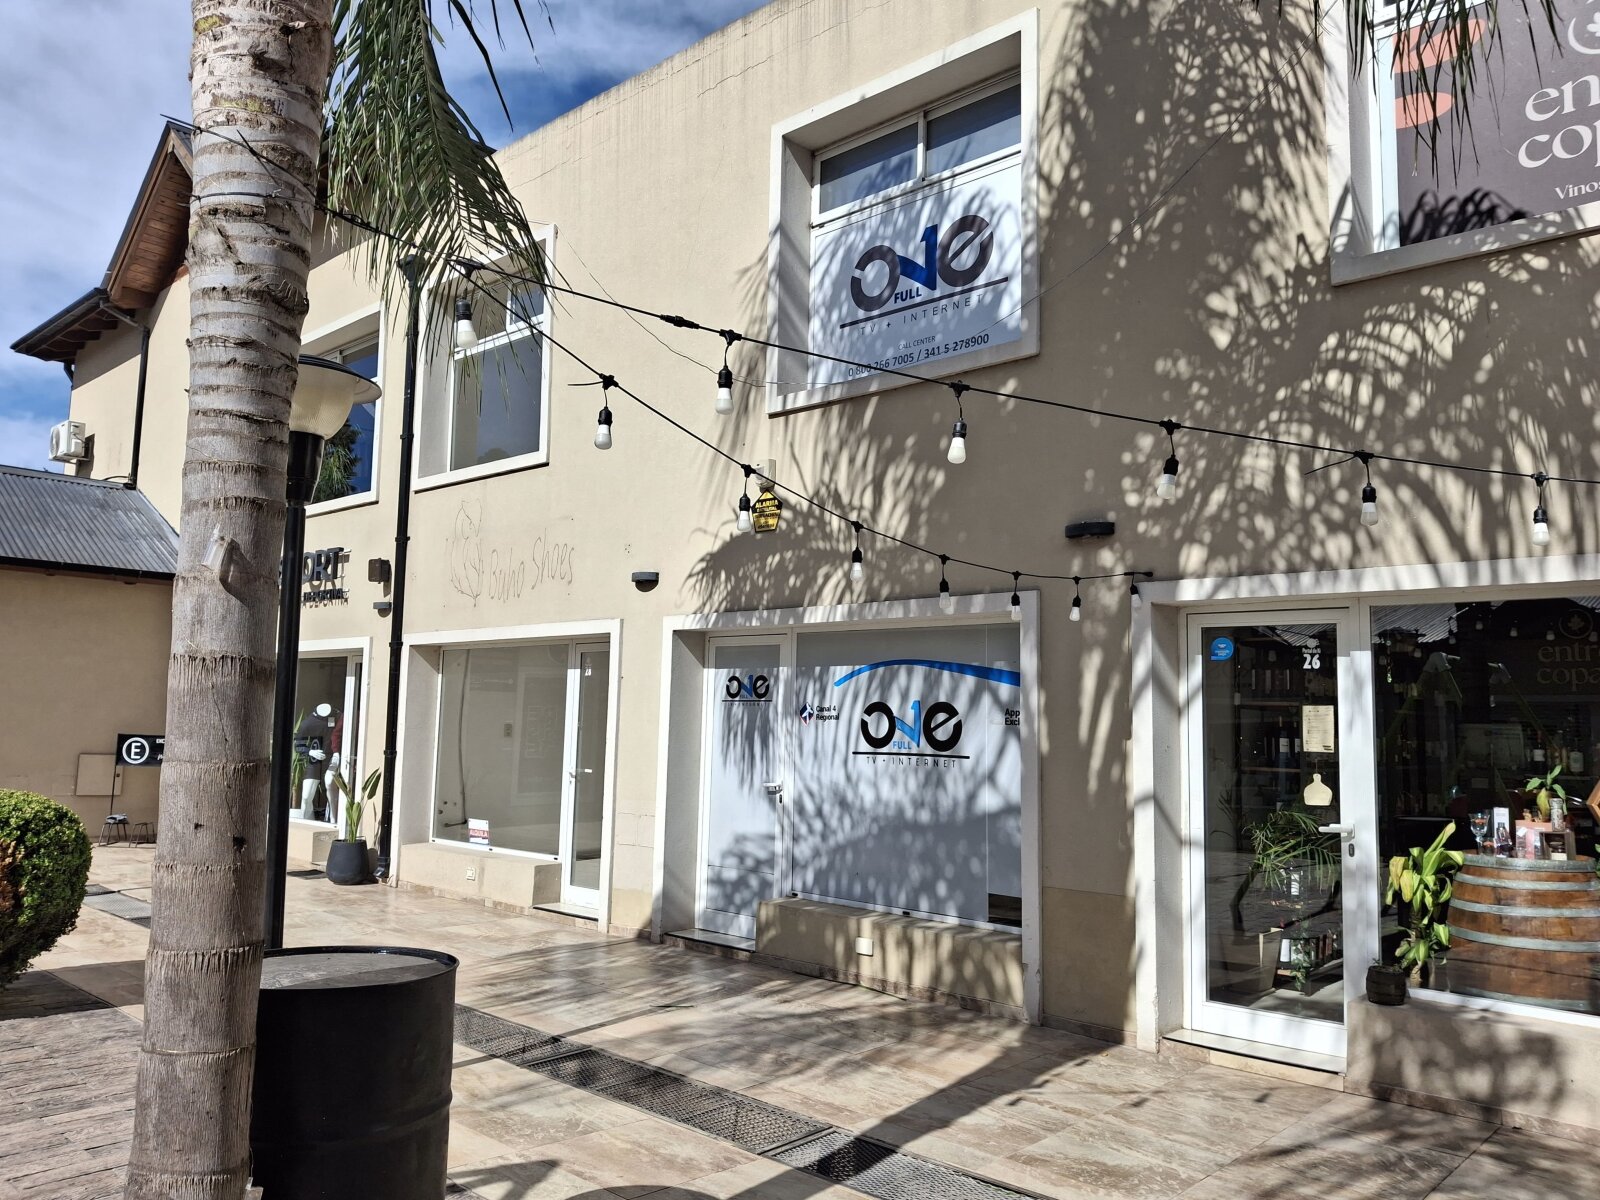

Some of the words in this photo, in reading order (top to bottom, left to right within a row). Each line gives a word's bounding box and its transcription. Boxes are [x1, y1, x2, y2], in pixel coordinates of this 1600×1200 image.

[893, 286, 923, 304] FULL
[860, 324, 876, 336] TV
[903, 293, 983, 324] INTERNET
[898, 339, 912, 351] CALL
[913, 335, 936, 347] CENTER
[848, 367, 853, 377] 0
[892, 352, 914, 367] 7005
[924, 345, 940, 359] 341
[944, 343, 950, 354] 5
[952, 333, 989, 352] 278900
[531, 527, 575, 590] Shoes
[1538, 641, 1600, 662] entr
[1303, 654, 1321, 669] 26
[816, 712, 840, 722] Regional
[893, 740, 912, 750] FULL
[866, 756, 877, 765] TV
[892, 757, 956, 768] INTERNET
